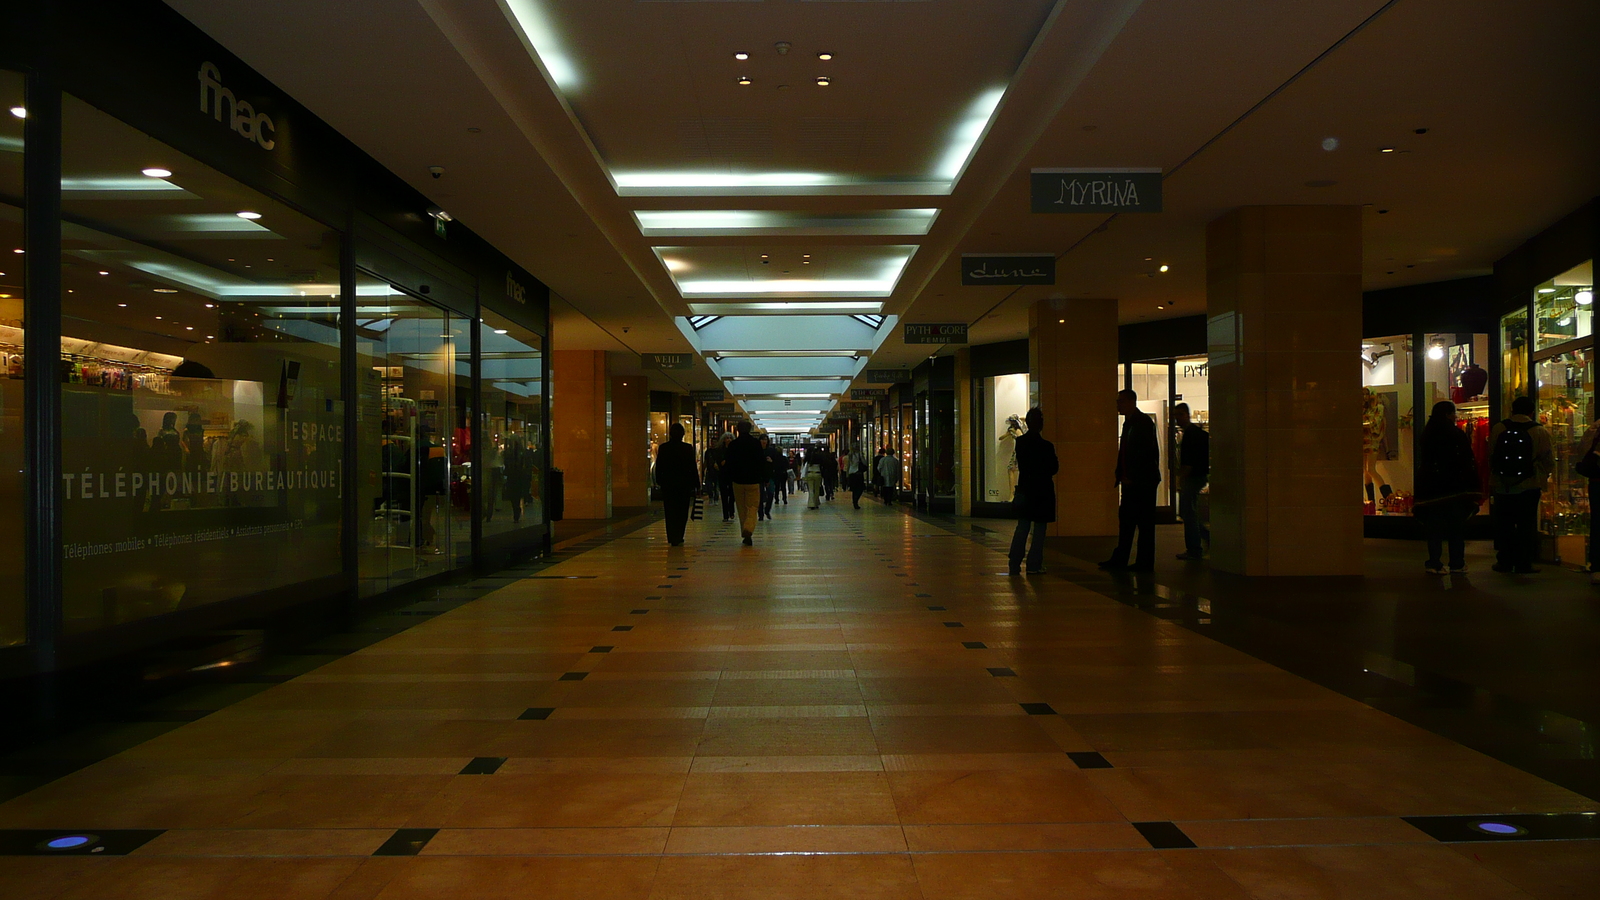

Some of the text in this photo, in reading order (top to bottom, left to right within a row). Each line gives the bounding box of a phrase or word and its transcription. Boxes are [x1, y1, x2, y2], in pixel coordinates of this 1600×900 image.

[197, 60, 275, 151] fnac
[1054, 176, 1140, 206] MYRINA
[506, 269, 526, 305] fnac
[654, 355, 682, 364] WEILL
[63, 537, 113, 560] Téléphones
[115, 533, 145, 552] mobiles
[154, 529, 193, 549] Téléphones
[194, 527, 230, 543] résidentiels
[236, 525, 263, 538] Assistants
[263, 521, 290, 536] personnels
